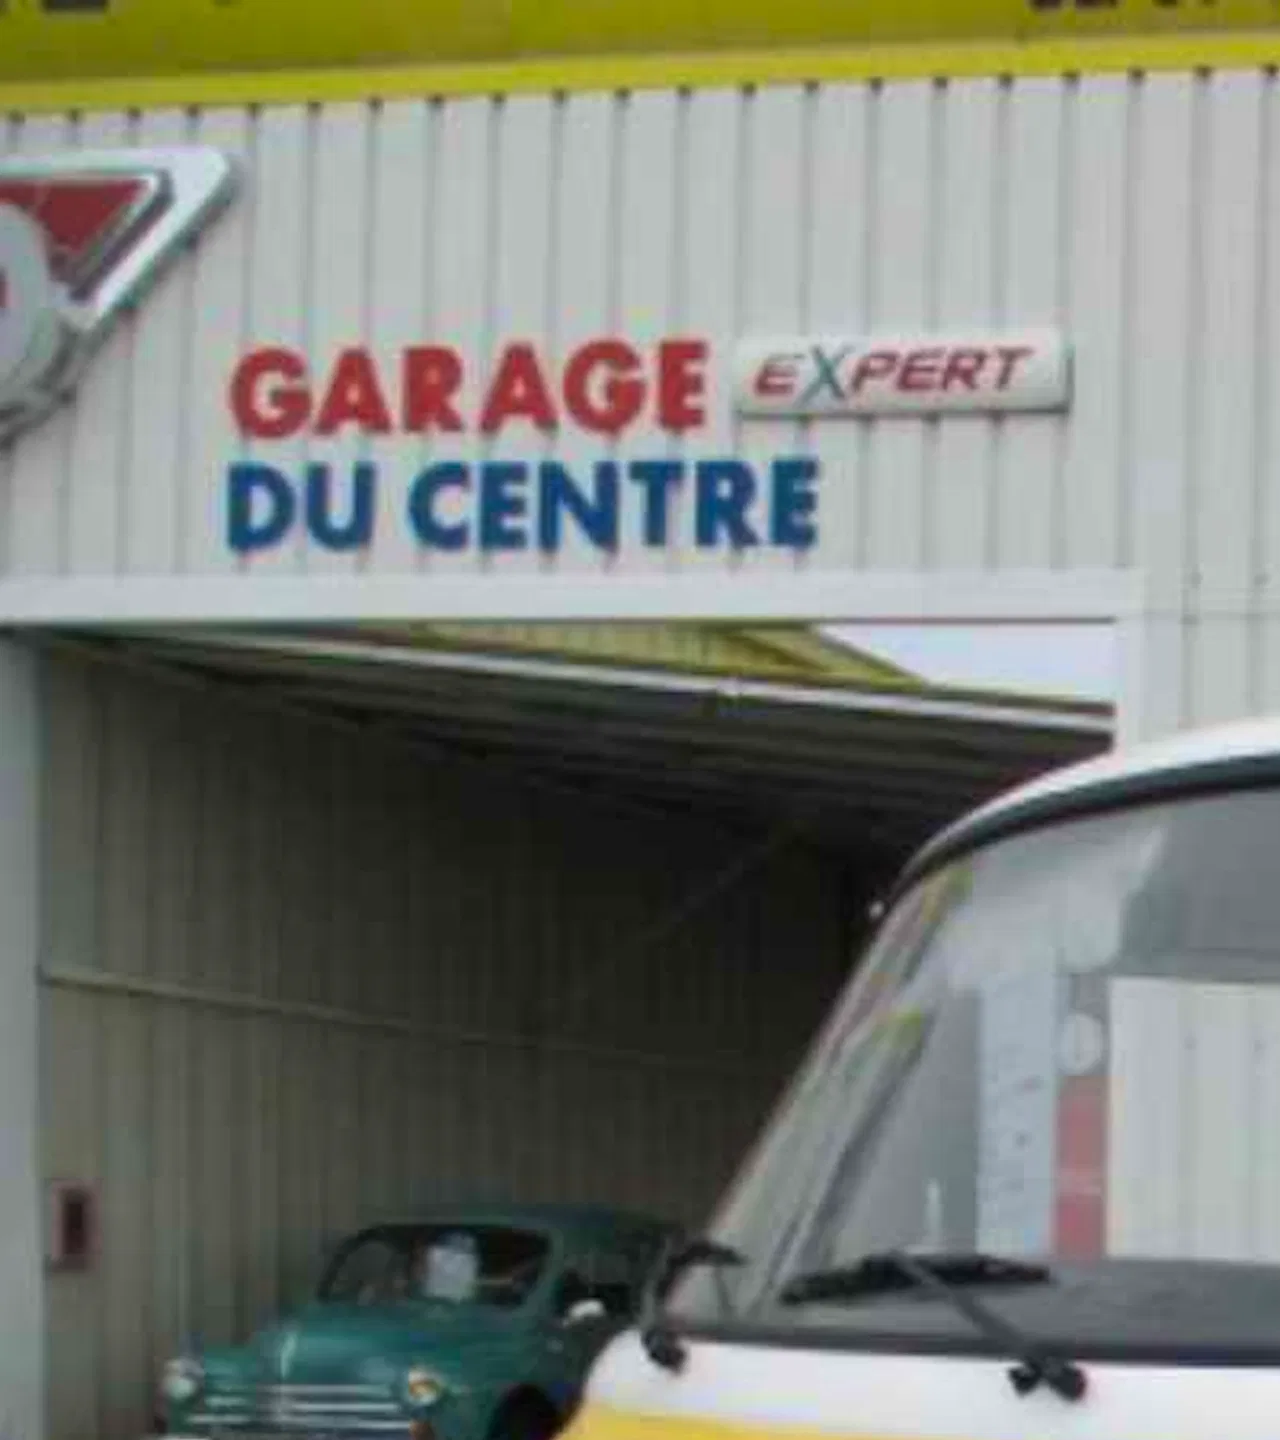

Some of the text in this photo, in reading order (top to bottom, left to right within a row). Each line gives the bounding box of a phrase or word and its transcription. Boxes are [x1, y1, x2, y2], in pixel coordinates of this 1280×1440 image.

[230, 339, 709, 438] GARAGE
[753, 346, 1036, 402] EXPERT
[227, 460, 820, 552] DU CENTRE
